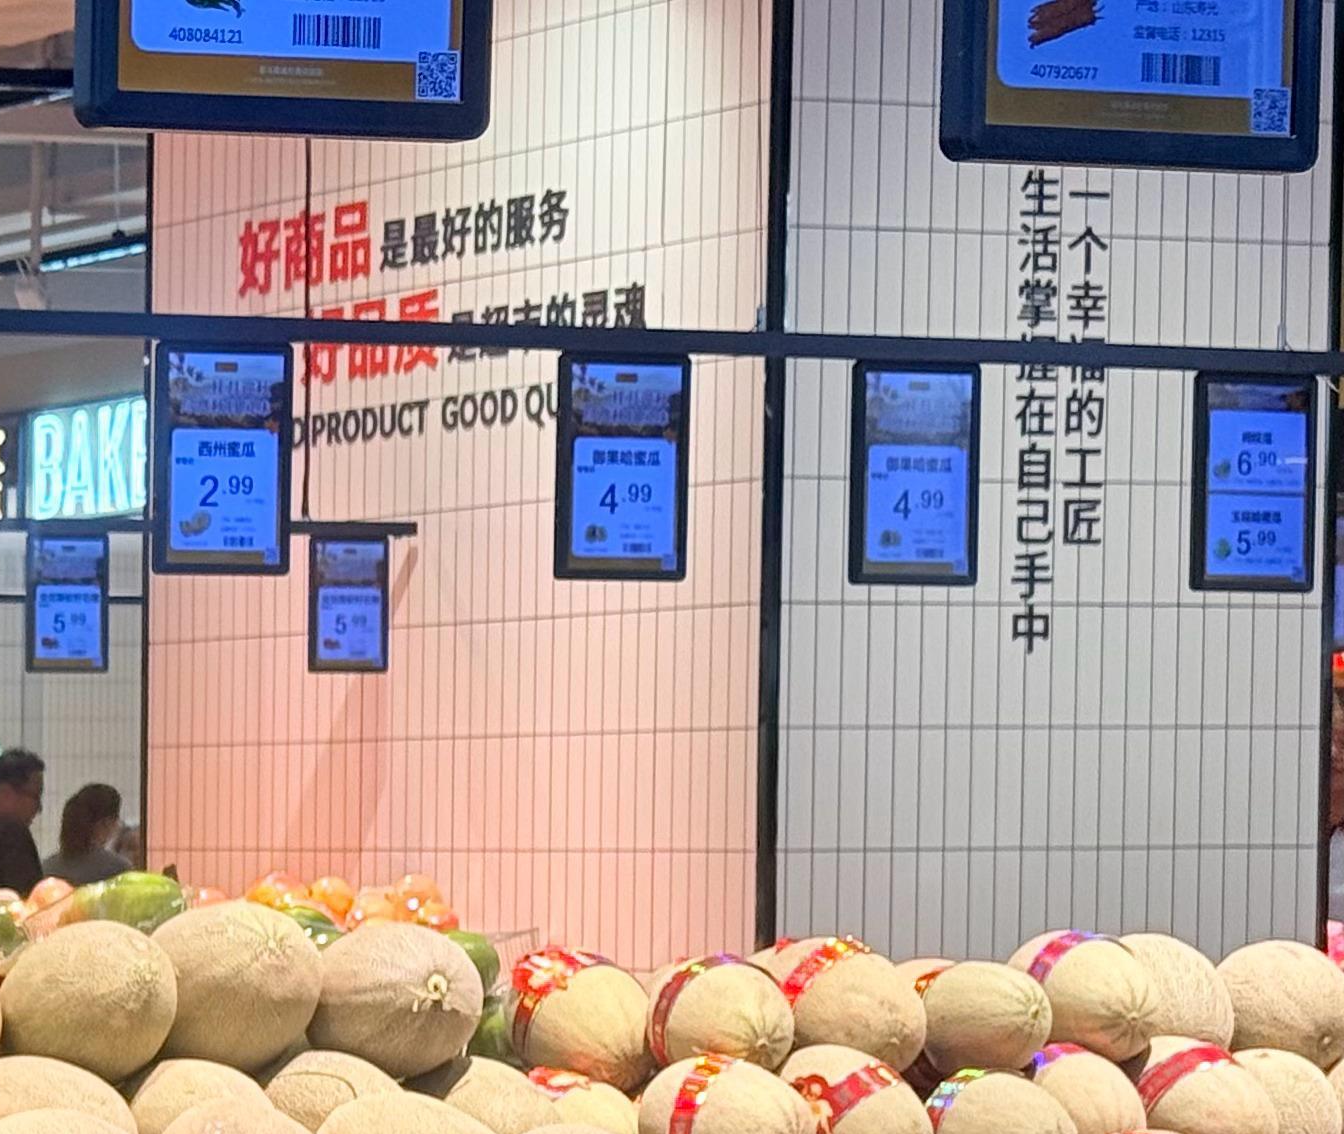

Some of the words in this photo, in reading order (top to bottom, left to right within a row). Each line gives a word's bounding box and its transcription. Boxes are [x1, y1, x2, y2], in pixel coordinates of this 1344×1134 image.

[168, 26, 244, 44] 408084121
[1030, 63, 1099, 81] 407920677
[239, 200, 370, 298] 好商品
[380, 188, 569, 273] 是最好的服务
[311, 401, 431, 450] PRODUCT
[441, 388, 518, 432] GOOD
[199, 475, 254, 507] 2.99
[599, 483, 652, 514] 4.99
[893, 489, 944, 521] 4.99
